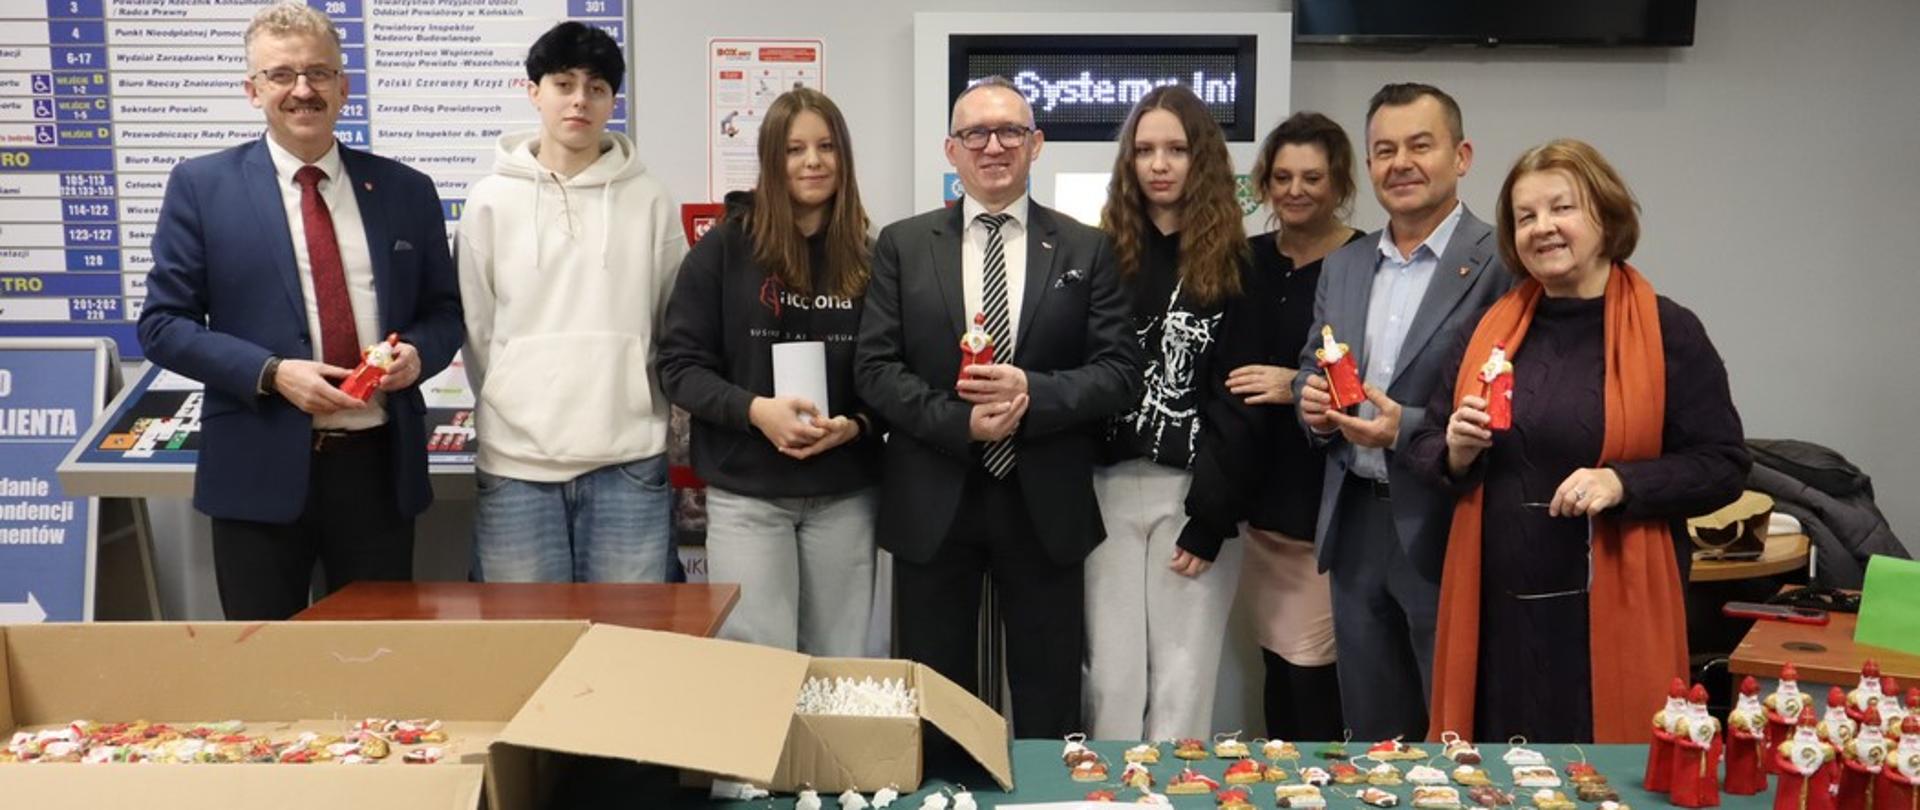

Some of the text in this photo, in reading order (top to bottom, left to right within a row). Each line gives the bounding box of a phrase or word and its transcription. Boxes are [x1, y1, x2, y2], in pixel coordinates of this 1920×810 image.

[70, 1, 78, 13] 3
[151, 8, 187, 17] Prawny
[411, 9, 464, 18] Powiatowy
[479, 8, 524, 16] Końskich
[72, 27, 79, 39] 4
[373, 24, 475, 33] Powiatowy Inspektor
[115, 29, 143, 37] Punkt
[146, 29, 207, 38] Nieodpłatnej
[416, 34, 482, 43] Budowlanego
[375, 49, 494, 58] Towarzystwo Wspierania
[66, 53, 92, 64] 6-17
[117, 54, 154, 63] Wydział
[156, 54, 214, 63] Zarządzania
[375, 60, 416, 69] Rozwoju
[147, 80, 180, 88] Rzeczy
[377, 79, 412, 87] Polski
[416, 79, 469, 89] Czerwony
[96, 99, 106, 110] C
[377, 104, 501, 113] Zarząd Dróg Powiatowych
[122, 131, 198, 139] Przewodniczący
[201, 131, 225, 139] Rady
[355, 131, 363, 142] A
[378, 130, 413, 138] Starszy
[416, 130, 461, 138] Inspektor
[125, 156, 149, 164] Biuro
[153, 156, 176, 165] Rady
[125, 181, 163, 189] Członek
